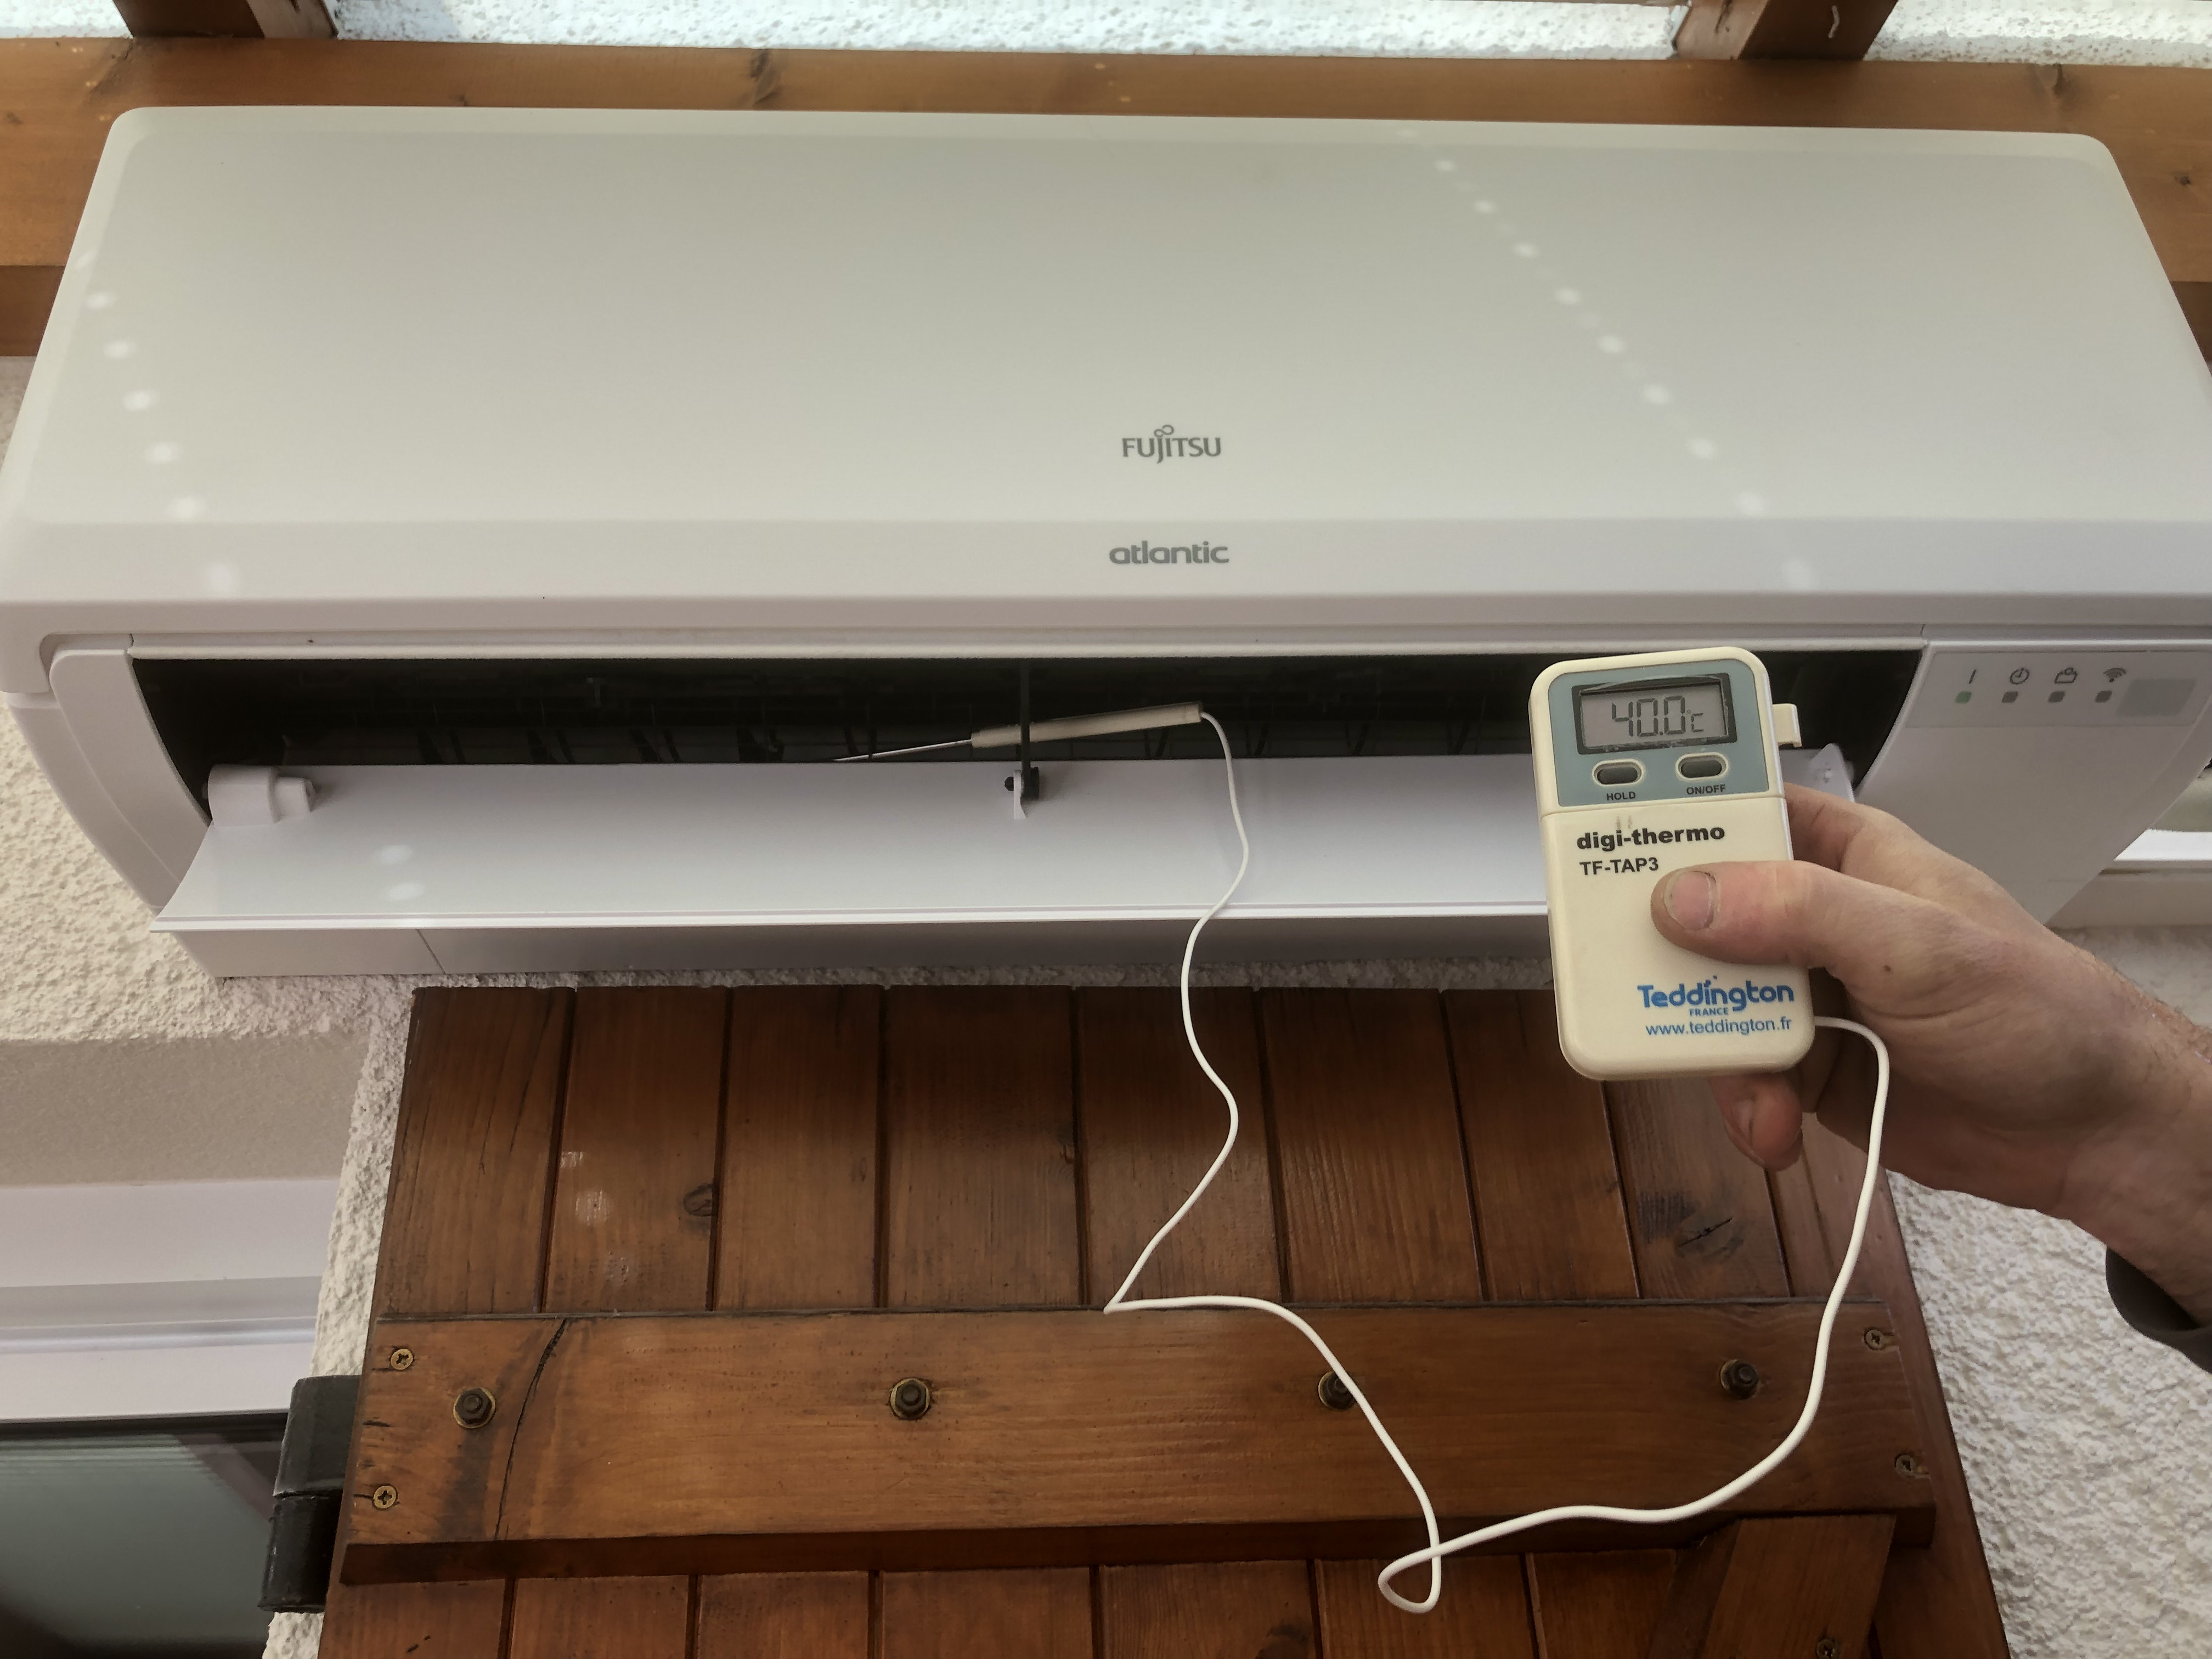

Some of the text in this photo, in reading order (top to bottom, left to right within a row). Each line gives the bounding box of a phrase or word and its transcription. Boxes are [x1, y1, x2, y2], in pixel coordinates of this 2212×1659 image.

[1122, 424, 1221, 464] FUJITSU
[1109, 540, 1229, 564] atlantic
[1606, 791, 1637, 801] HOLD
[1686, 784, 1726, 795] ON/OFF
[1577, 827, 1725, 851] digi-thermo
[1579, 857, 1659, 876] TF-TAP3
[1637, 975, 1794, 1012] Teddington
[1689, 1007, 1729, 1017] FRANCE
[1645, 1016, 1792, 1036] www.teddington.fr
